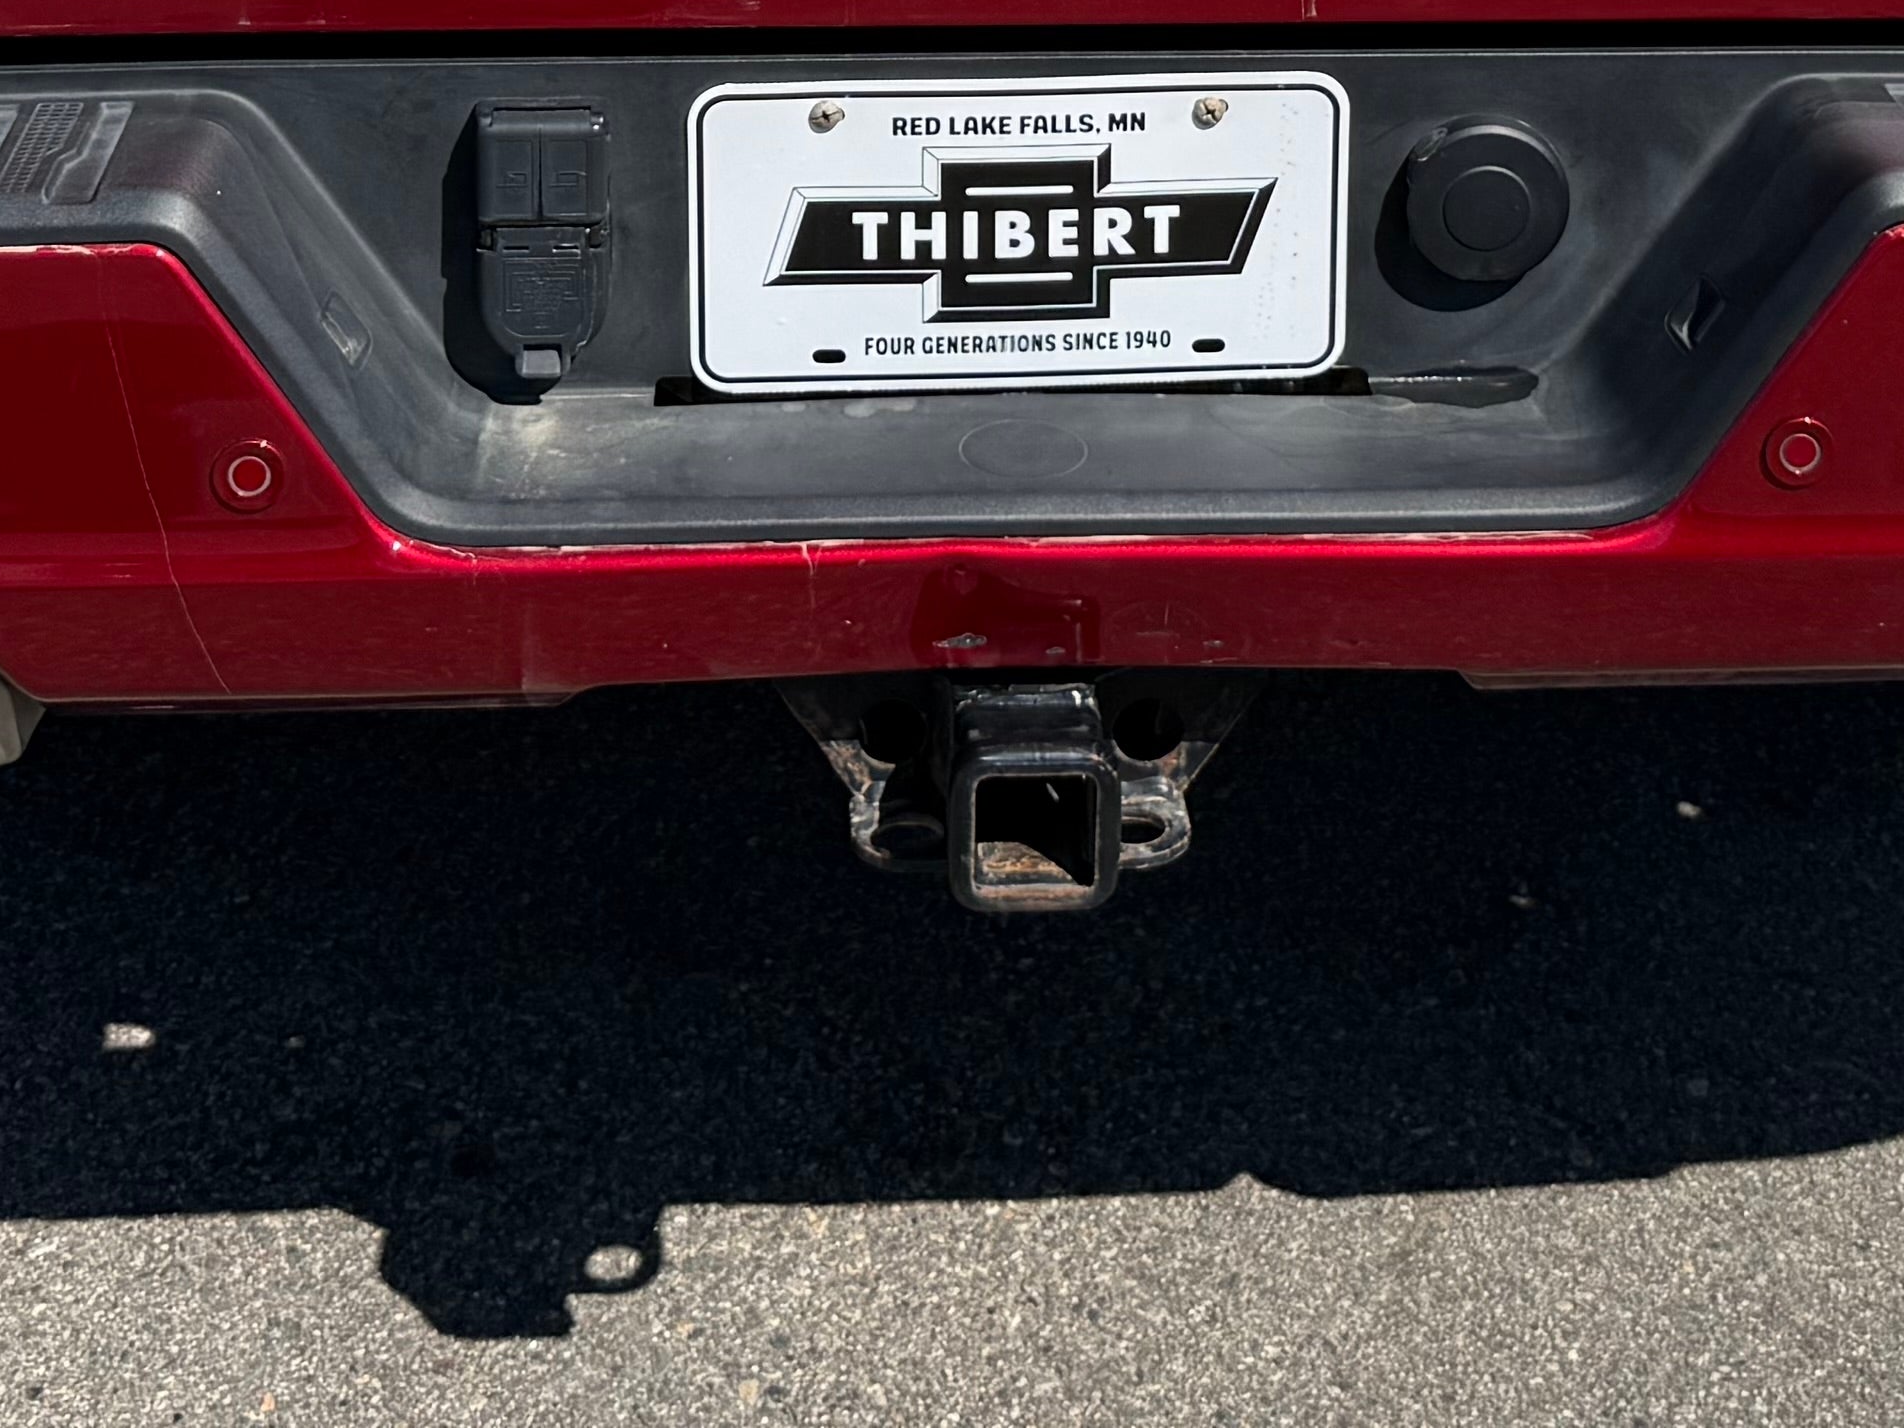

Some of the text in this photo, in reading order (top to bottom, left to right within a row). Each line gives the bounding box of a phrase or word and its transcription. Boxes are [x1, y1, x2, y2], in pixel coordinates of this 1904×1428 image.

[892, 111, 1146, 136] RED LAKE FALLS, MN
[851, 204, 1181, 261] THIBERT
[864, 329, 1172, 356] FOUR GENERATIONS SINCE 1940
